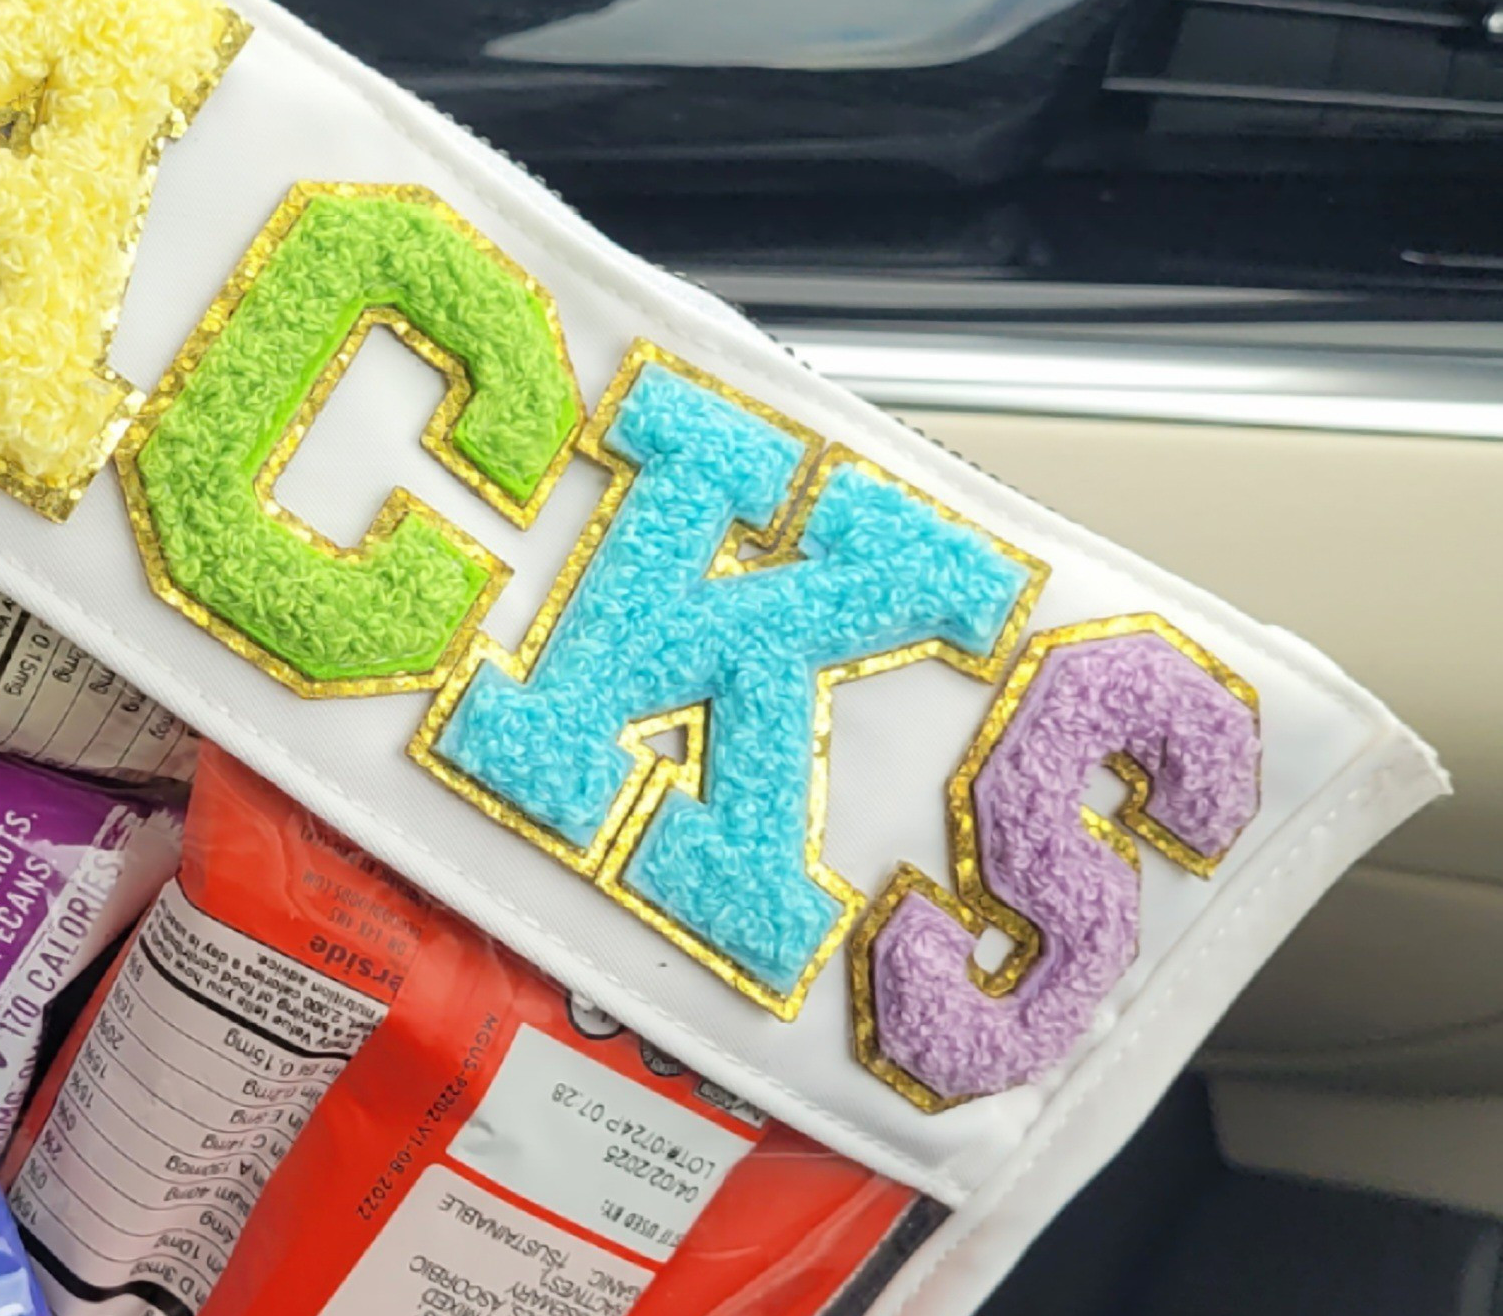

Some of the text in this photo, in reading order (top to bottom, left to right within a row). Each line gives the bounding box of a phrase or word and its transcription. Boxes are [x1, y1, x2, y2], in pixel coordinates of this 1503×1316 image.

[3, 632, 48, 699] 0.15mg
[23, 851, 126, 995] CALORIES
[201, 941, 229, 964] day
[205, 978, 234, 1000] you
[219, 969, 329, 1033] serving of food
[243, 963, 301, 1002] calories
[235, 995, 268, 1022] tells
[271, 1013, 311, 1045] Value
[223, 1026, 294, 1078] 0.15mg
[601, 1142, 700, 1204] 04/02/2025
[622, 1209, 659, 1240] USED
[407, 1251, 506, 1313] ASCORBIC
